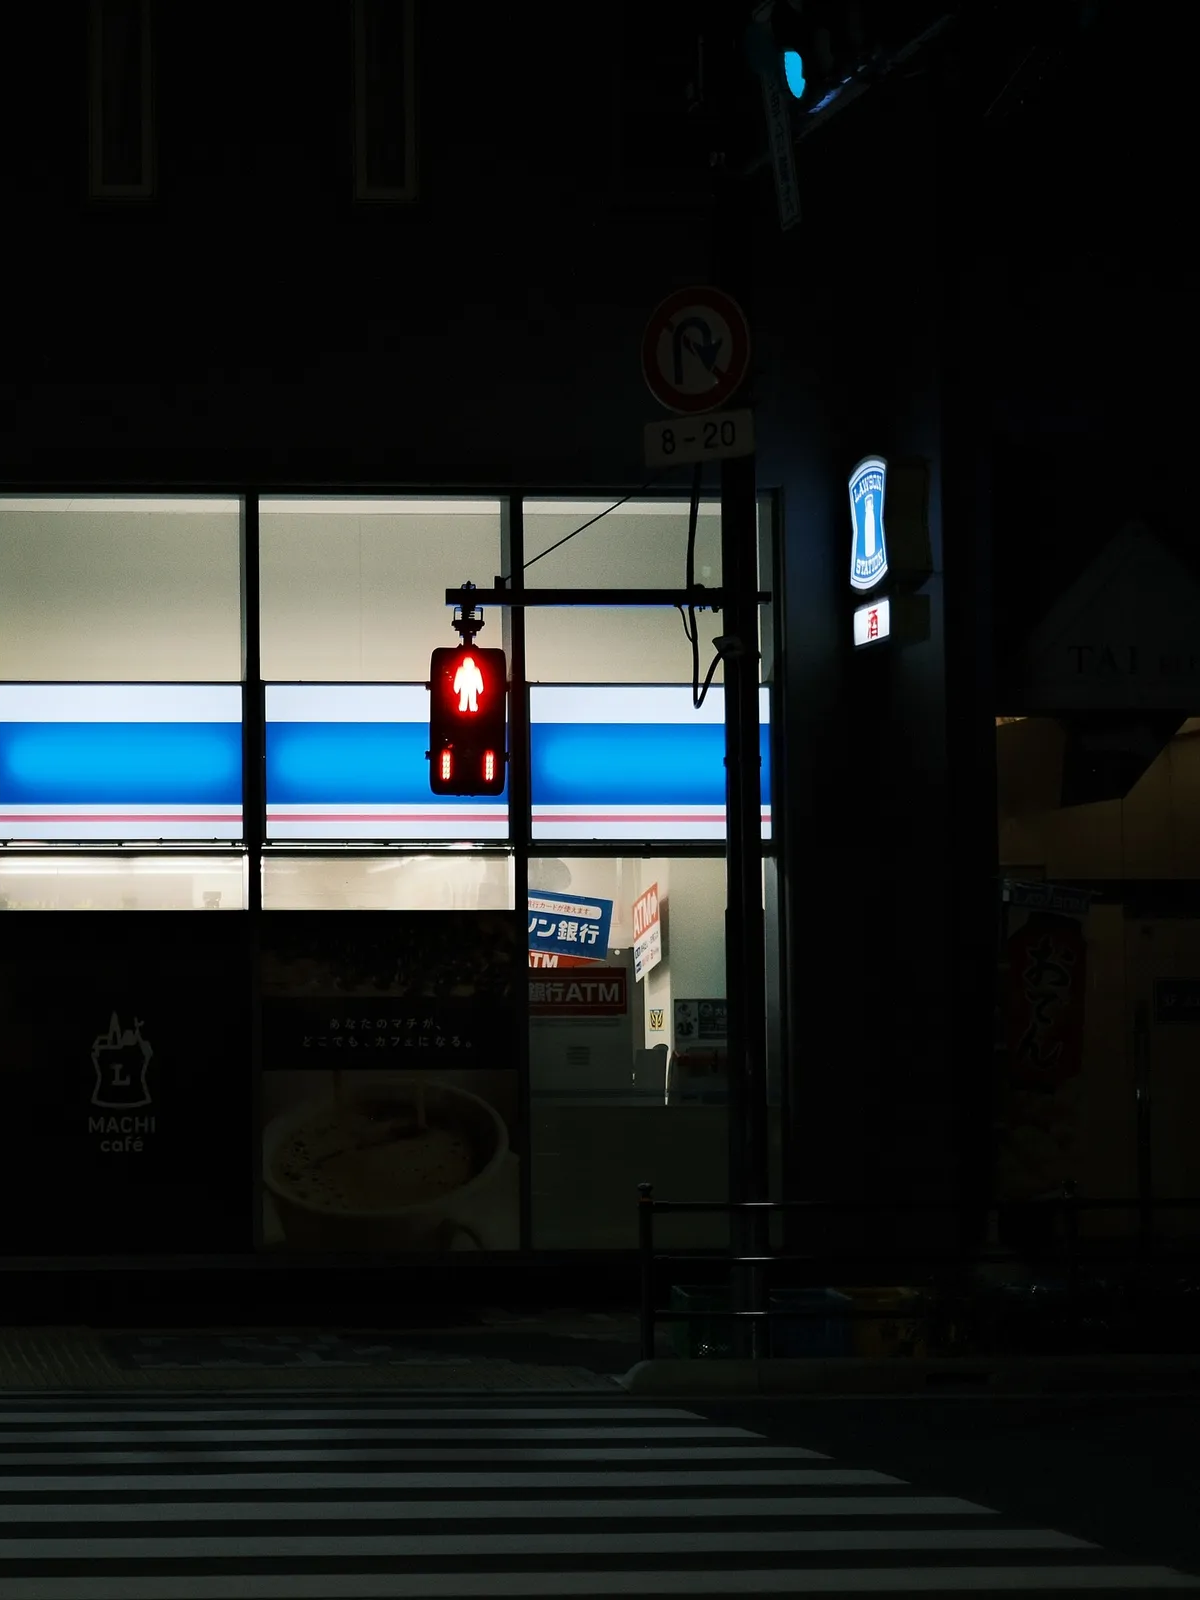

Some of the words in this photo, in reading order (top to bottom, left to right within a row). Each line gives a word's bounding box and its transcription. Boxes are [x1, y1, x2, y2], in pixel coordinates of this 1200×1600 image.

[661, 420, 736, 455] 8-20
[853, 474, 883, 504] LAWSON
[855, 549, 884, 577] STATION
[867, 608, 879, 640] 酒
[329, 1016, 442, 1031] あなたのマチが、
[301, 1036, 473, 1049] どこでも、カフェになる。
[109, 1063, 131, 1087] L
[87, 1115, 157, 1134] MACHI
[99, 1136, 144, 1153] café
